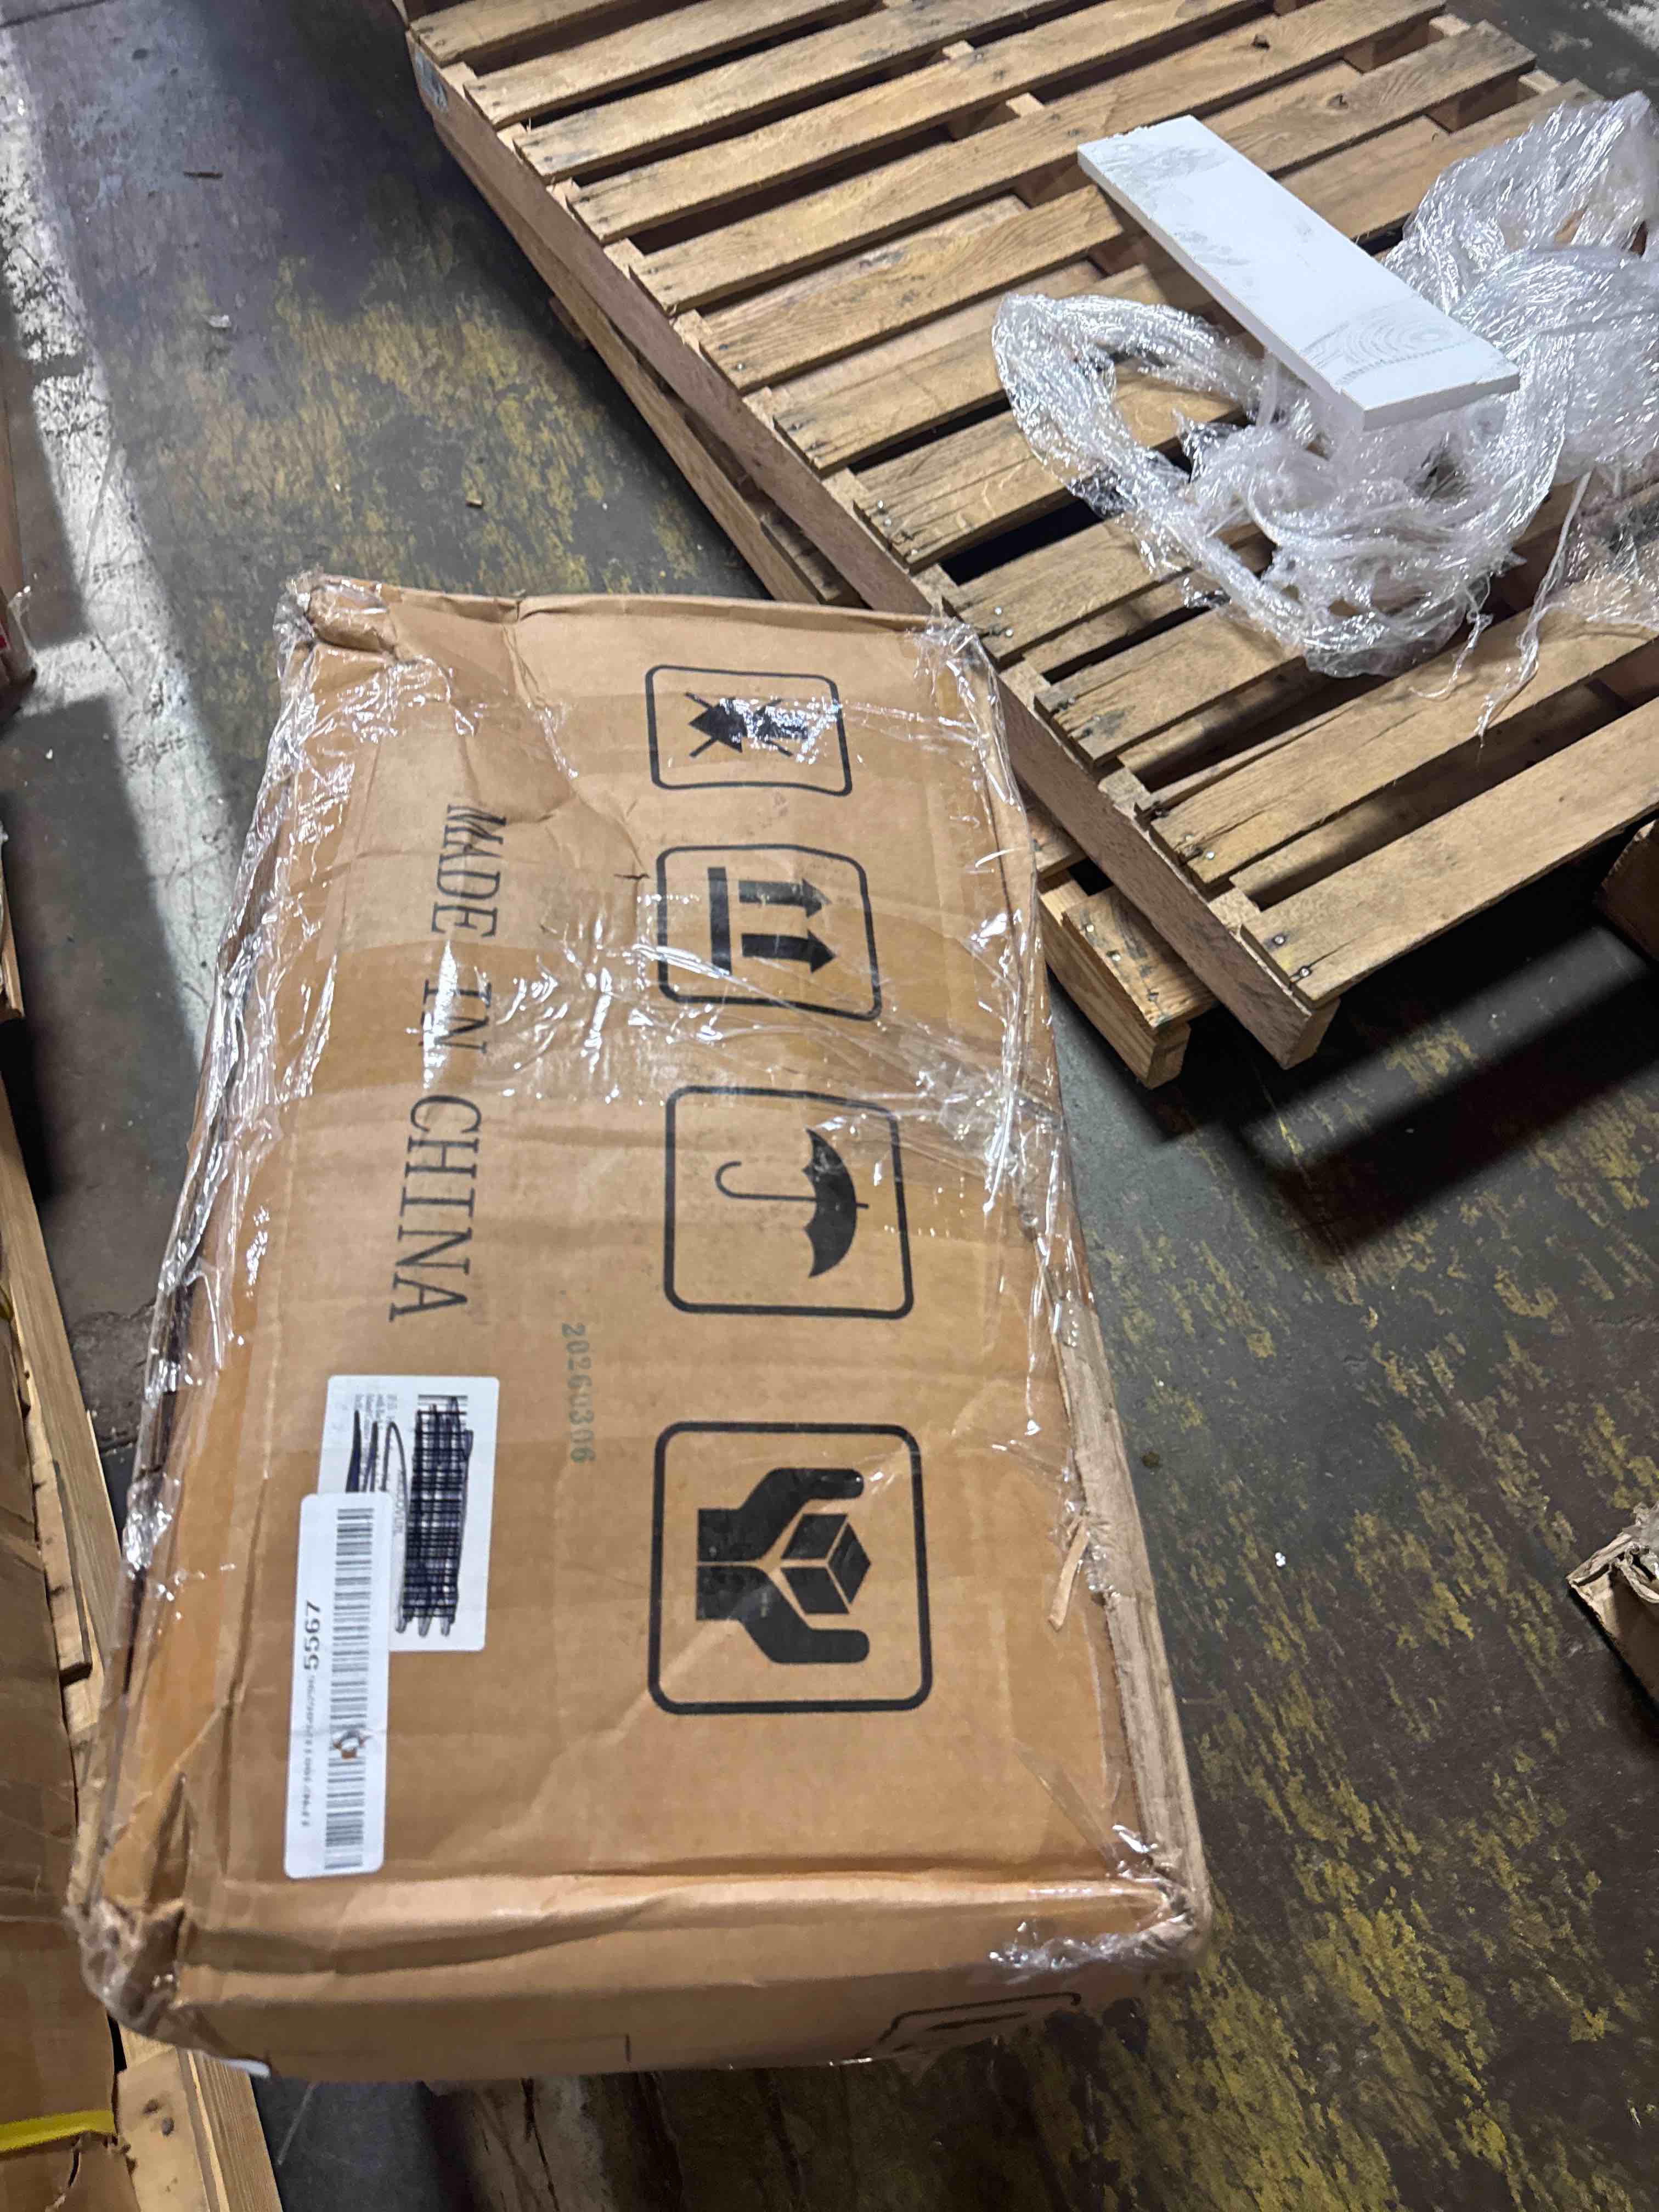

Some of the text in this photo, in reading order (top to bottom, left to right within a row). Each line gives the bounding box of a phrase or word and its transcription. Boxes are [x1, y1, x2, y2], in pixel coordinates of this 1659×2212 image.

[389, 804, 507, 1322] MADE IN CHINA
[303, 1600, 321, 1671] 5567
